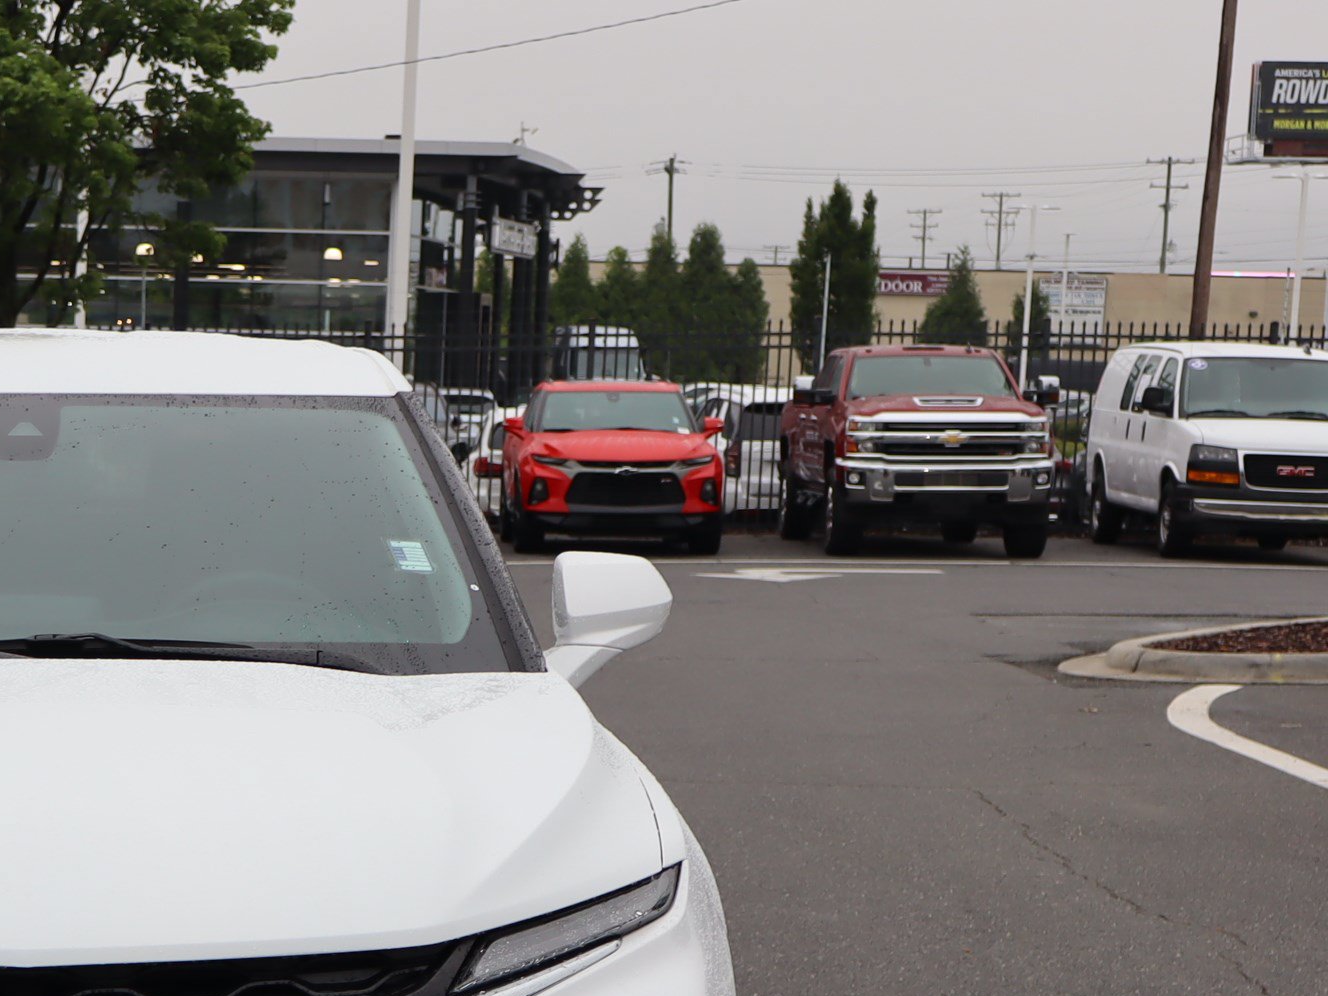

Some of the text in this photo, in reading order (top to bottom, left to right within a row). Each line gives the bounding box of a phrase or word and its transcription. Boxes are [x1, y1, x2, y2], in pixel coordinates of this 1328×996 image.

[1274, 69, 1321, 78] AMERICA'S
[1274, 120, 1305, 130] MORGAN
[1277, 465, 1315, 477] GMC
